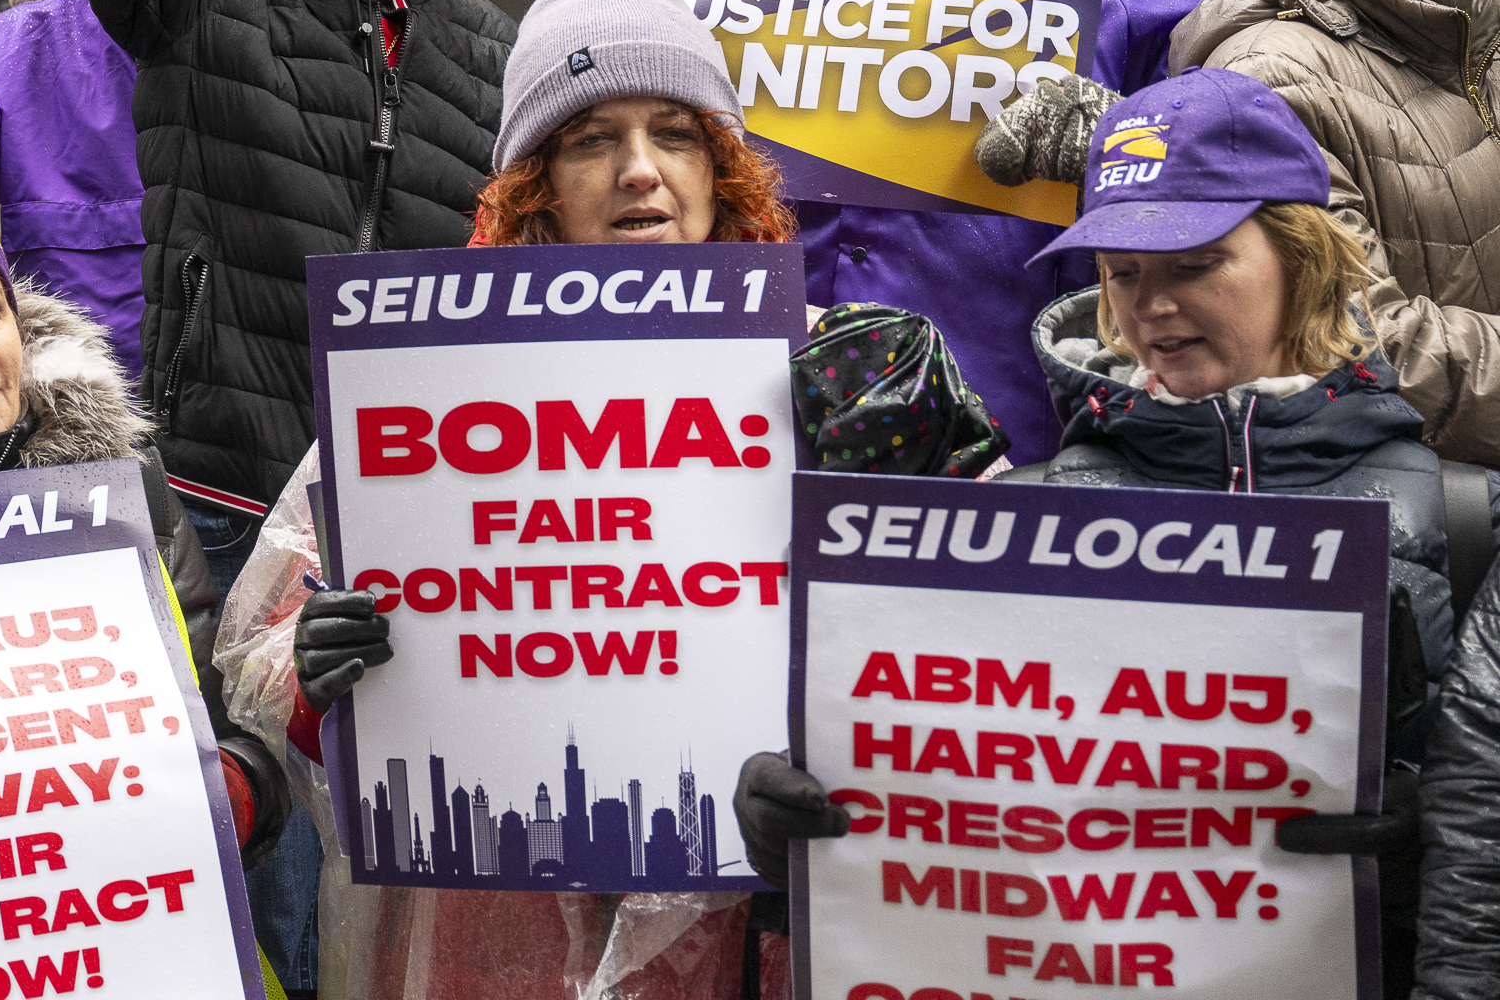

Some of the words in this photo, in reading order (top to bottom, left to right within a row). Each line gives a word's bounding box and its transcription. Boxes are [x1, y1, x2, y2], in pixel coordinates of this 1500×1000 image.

[715, 40, 1075, 123] NITOR
[1114, 116, 1148, 131] LOCAL
[1154, 114, 1163, 124] 1
[1094, 161, 1163, 192] SEIU
[332, 272, 494, 326] SEIU
[507, 268, 725, 316] LOCAL
[741, 269, 768, 313] 1
[355, 397, 771, 478] BOMA:
[87, 484, 110, 527] 1
[471, 497, 654, 545] FAIR
[818, 503, 1016, 564] SEIU
[1028, 514, 1290, 578] LOCAL
[1309, 528, 1344, 581] 1
[353, 561, 789, 614] CONTRACT
[458, 630, 680, 679] NOW!
[851, 650, 1075, 721] ABM,
[1099, 666, 1313, 735] AUJ,
[851, 721, 1312, 800] HARVARD,
[881, 859, 1280, 922] MIDWAY:
[986, 934, 1175, 988] FAIR
